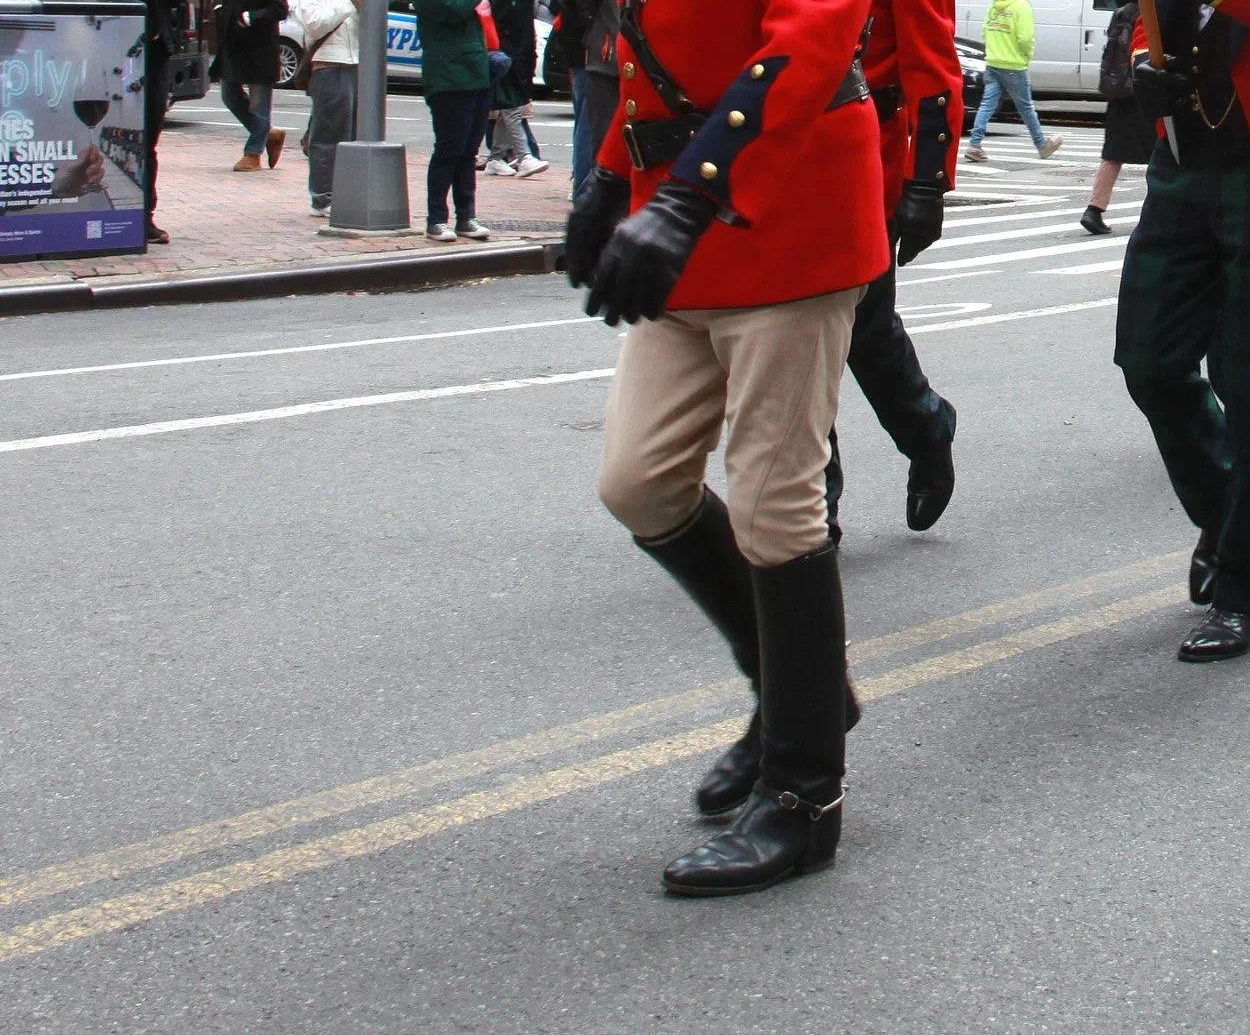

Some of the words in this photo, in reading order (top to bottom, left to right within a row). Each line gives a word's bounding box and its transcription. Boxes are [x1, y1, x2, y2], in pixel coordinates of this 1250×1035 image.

[387, 28, 422, 51] YPD
[16, 140, 78, 162] SMALL
[0, 163, 55, 185] ESSES
